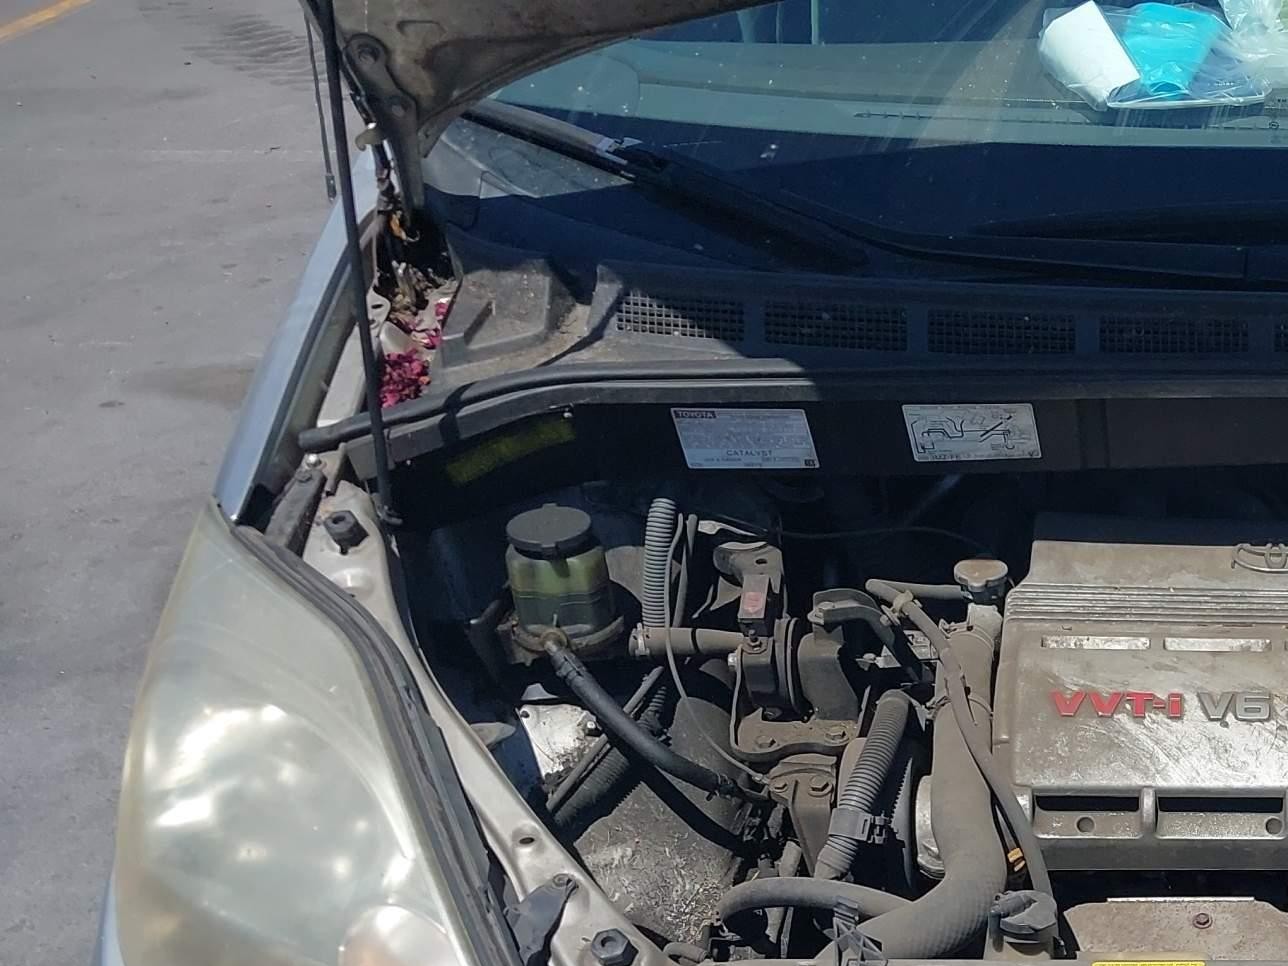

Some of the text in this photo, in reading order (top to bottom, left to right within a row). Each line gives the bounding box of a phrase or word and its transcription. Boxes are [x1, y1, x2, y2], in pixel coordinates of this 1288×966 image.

[677, 410, 715, 418] TOYOTA
[726, 449, 773, 457] CATALYST
[1052, 692, 1185, 717] VVT-i
[1197, 692, 1272, 721] V6
